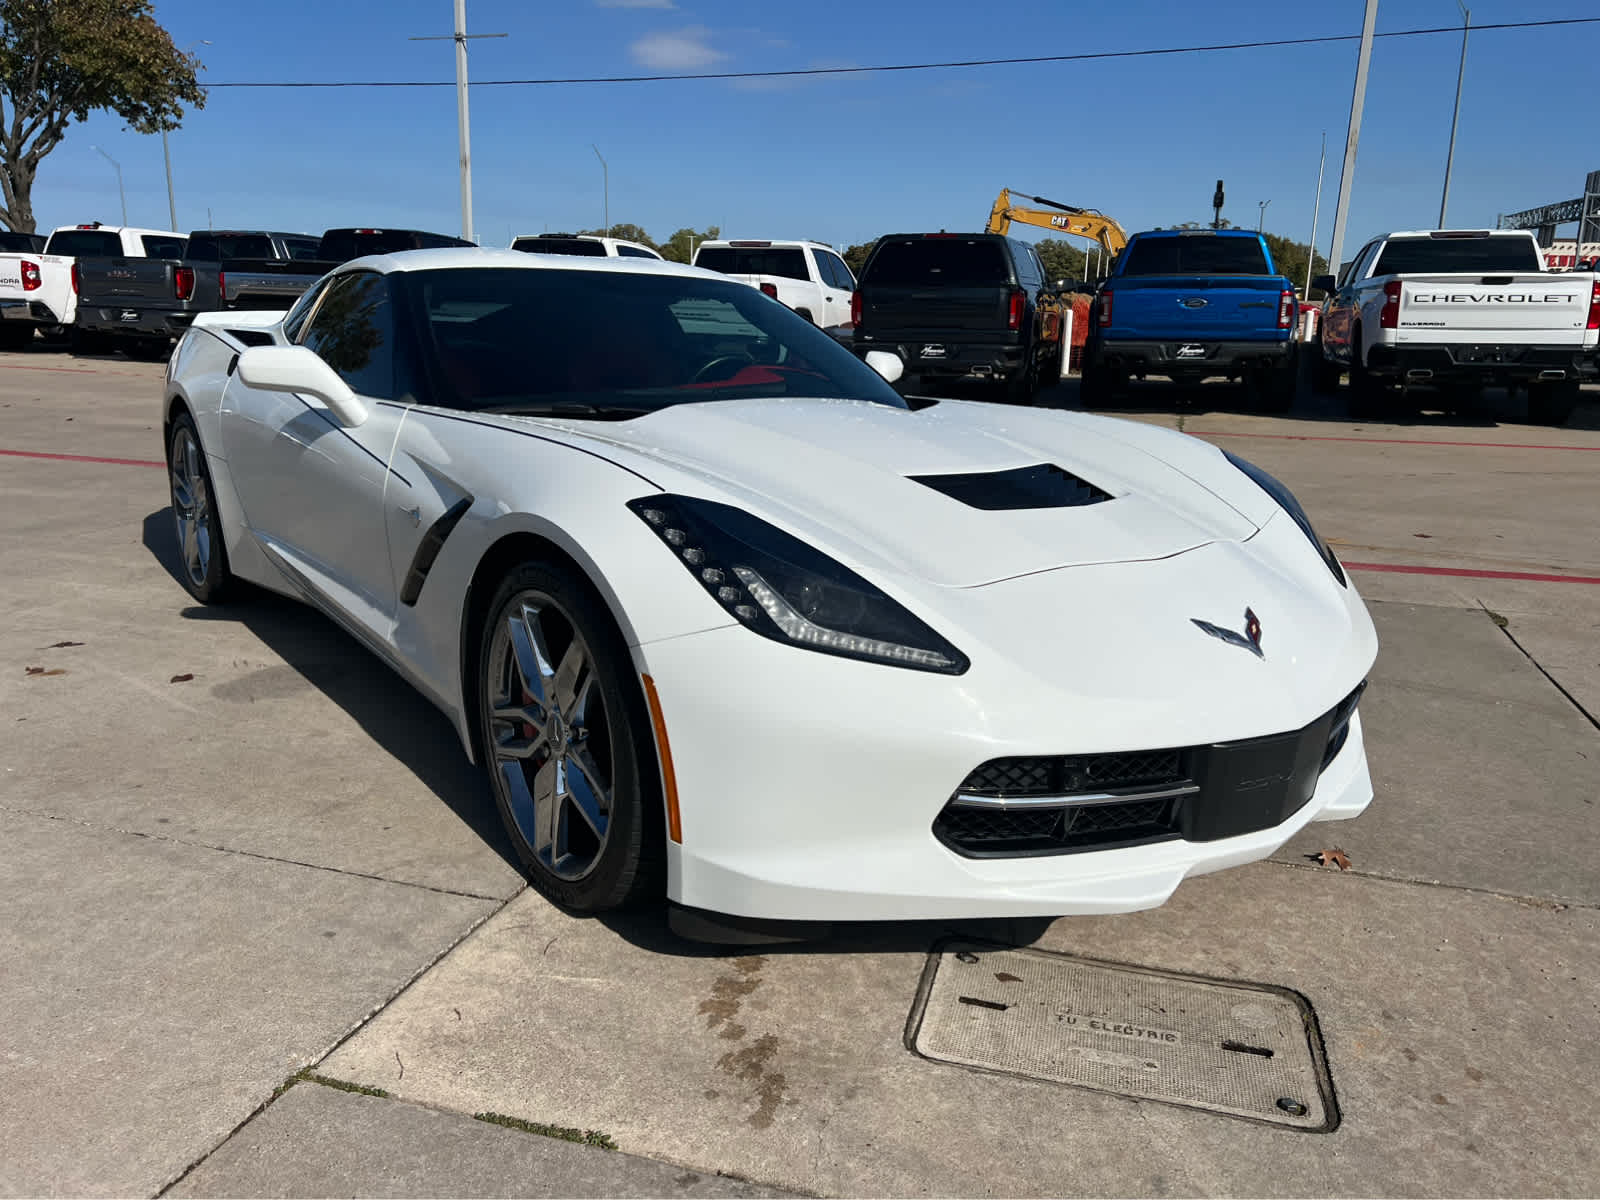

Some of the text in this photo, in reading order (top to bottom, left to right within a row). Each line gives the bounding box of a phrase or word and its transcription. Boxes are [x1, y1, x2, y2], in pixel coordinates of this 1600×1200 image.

[1051, 215, 1067, 227] CAT
[1414, 294, 1578, 303] CHEVROLET
[1089, 1019, 1178, 1043] ELECTRIC
